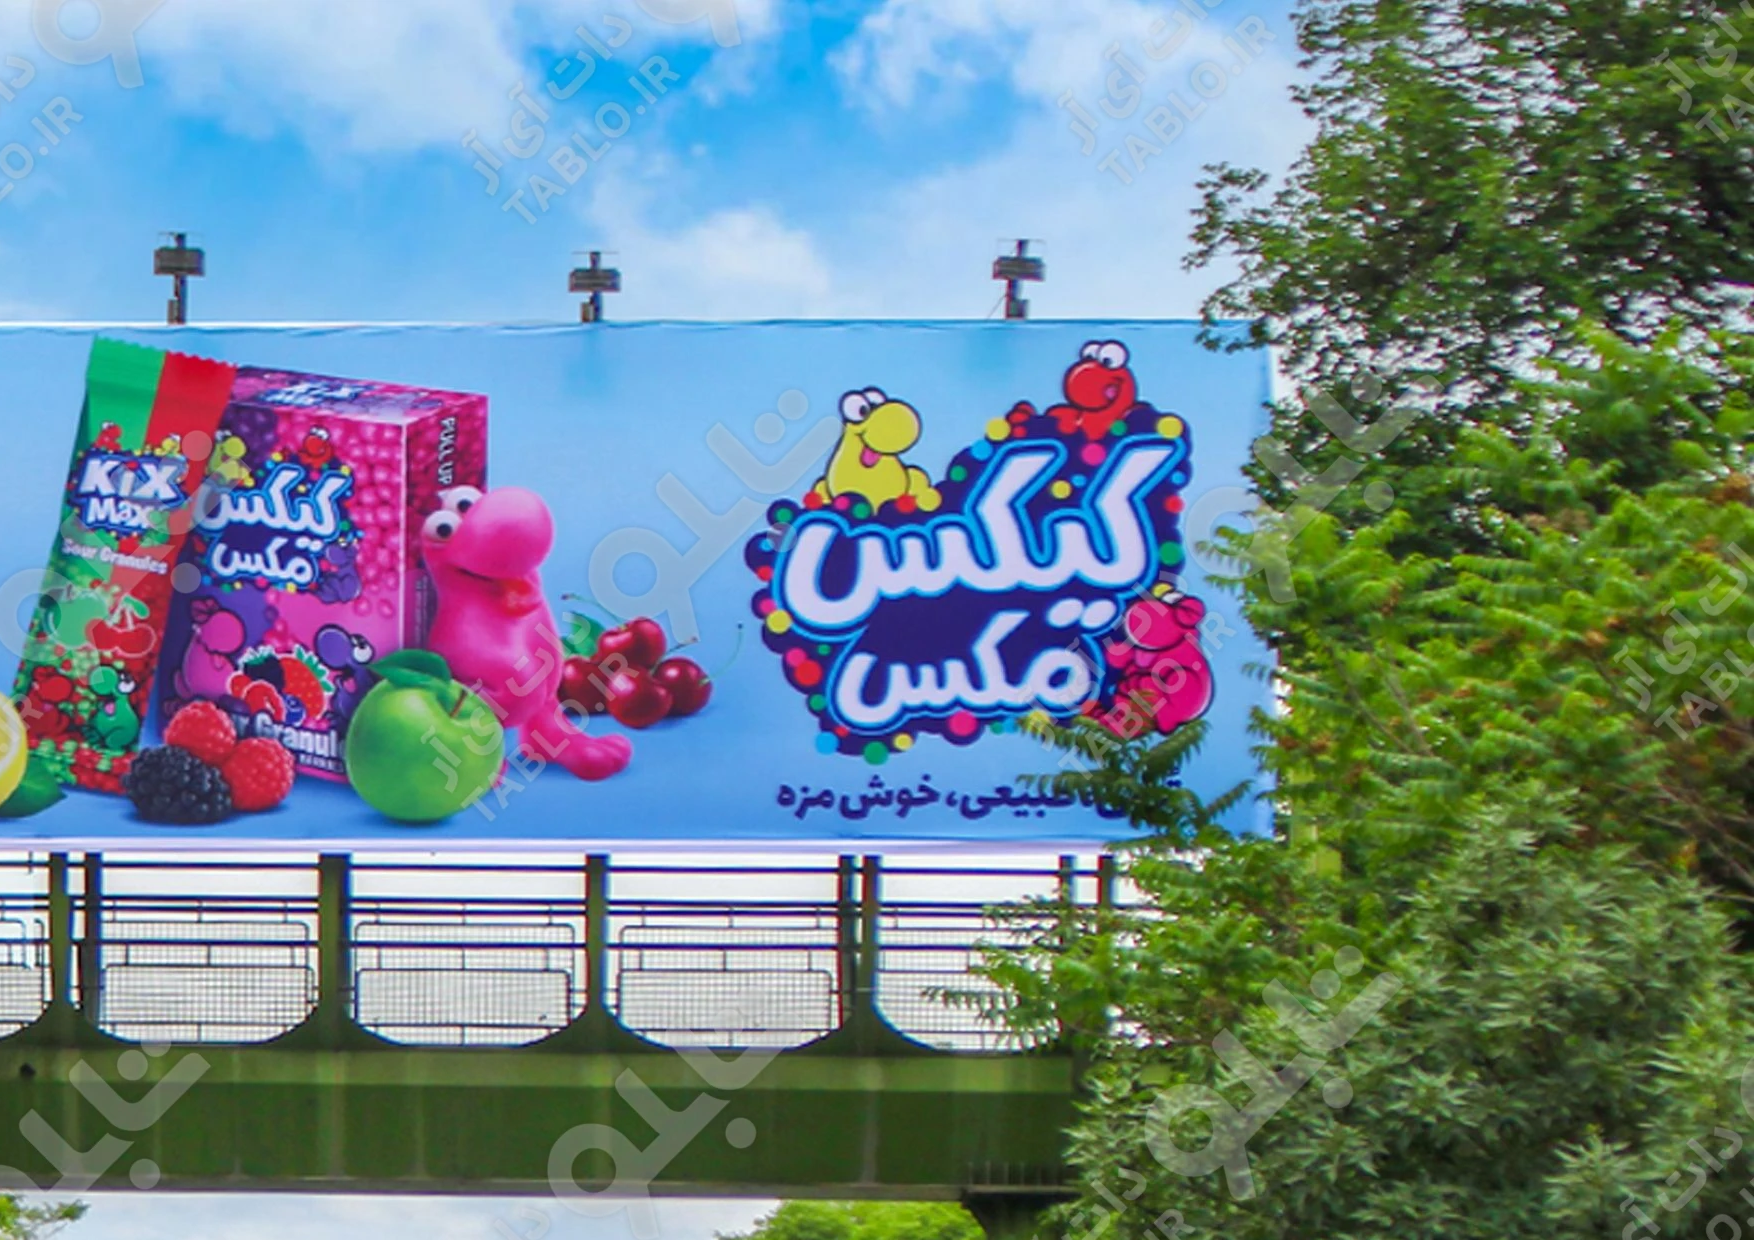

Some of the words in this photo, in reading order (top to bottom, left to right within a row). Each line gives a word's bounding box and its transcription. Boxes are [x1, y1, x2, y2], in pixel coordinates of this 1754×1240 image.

[198, 468, 347, 552] کیکس
[211, 536, 314, 584] مکس
[784, 447, 1176, 628] کیکس
[837, 610, 1093, 721] مکس
[254, 711, 338, 758] Granul
[776, 783, 835, 821] مزه
[838, 773, 941, 820] خوش
